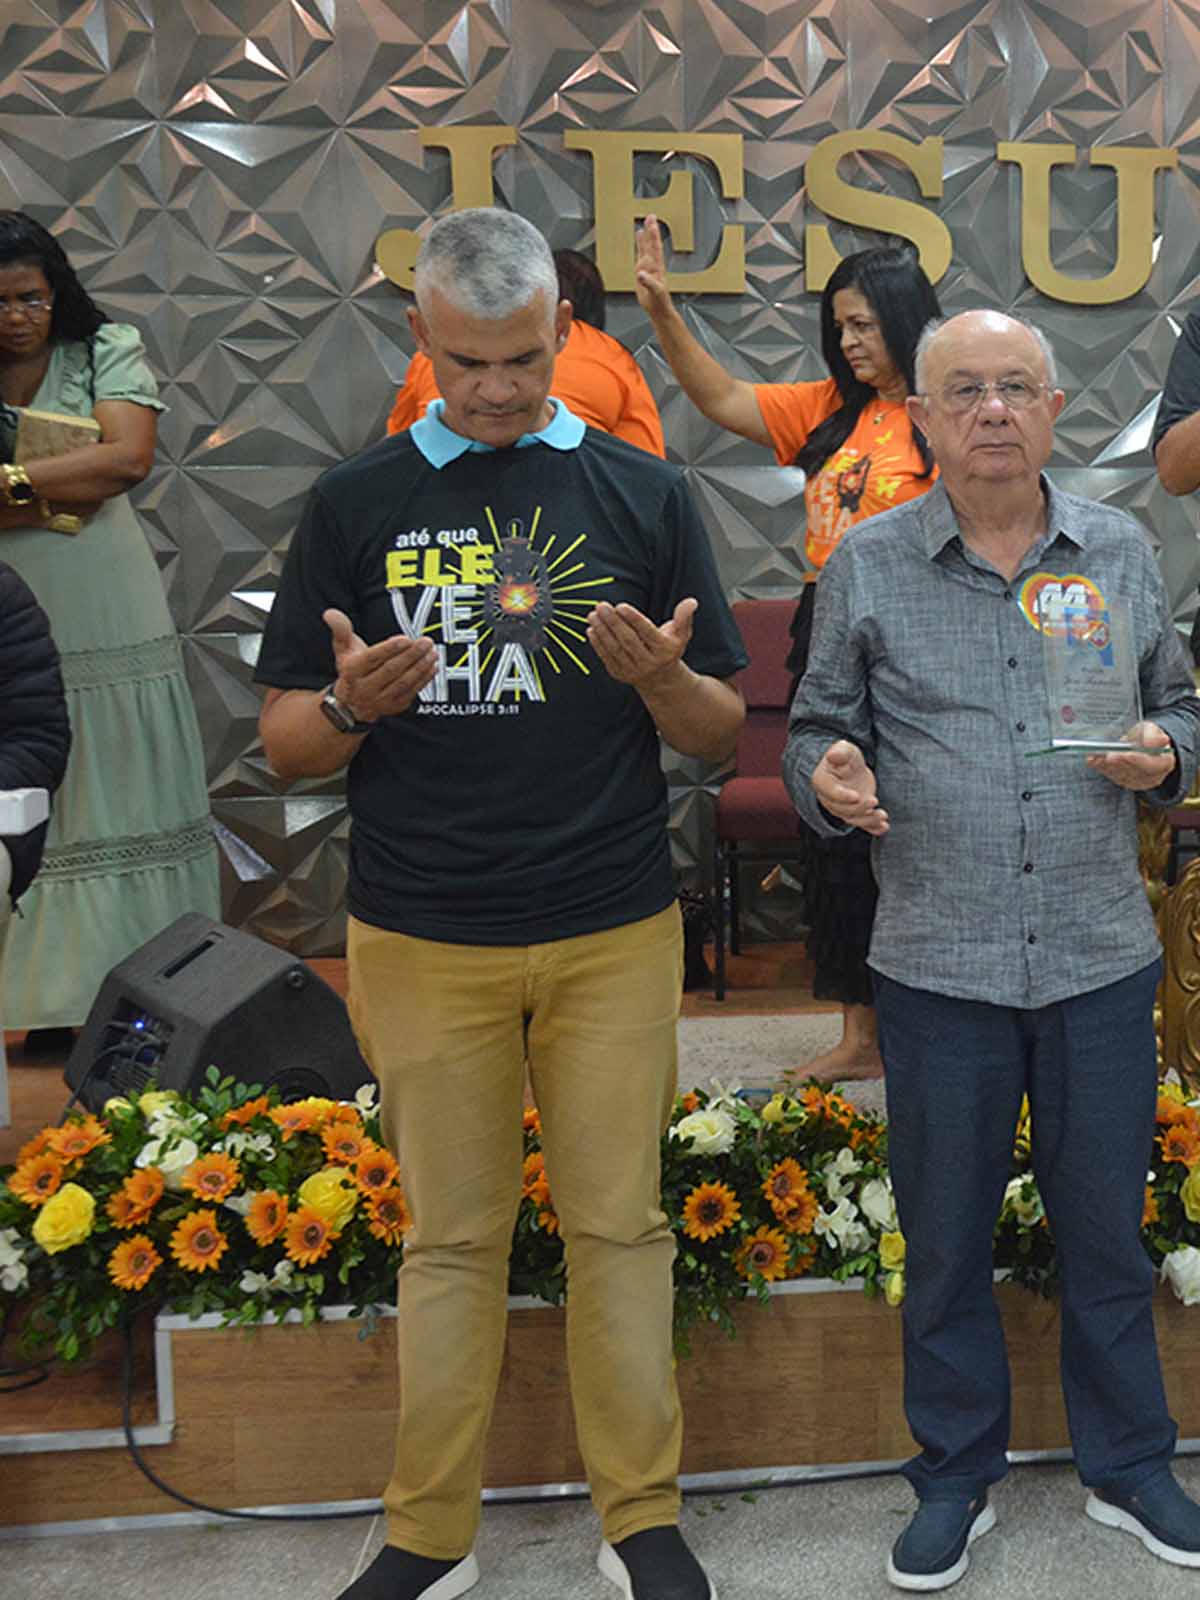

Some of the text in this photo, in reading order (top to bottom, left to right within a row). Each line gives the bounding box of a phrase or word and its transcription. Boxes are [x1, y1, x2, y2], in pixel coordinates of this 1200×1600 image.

[395, 527, 478, 549] até que
[385, 544, 496, 589] ELE
[389, 584, 478, 644] VE
[417, 704, 495, 716] APOCALIPSE
